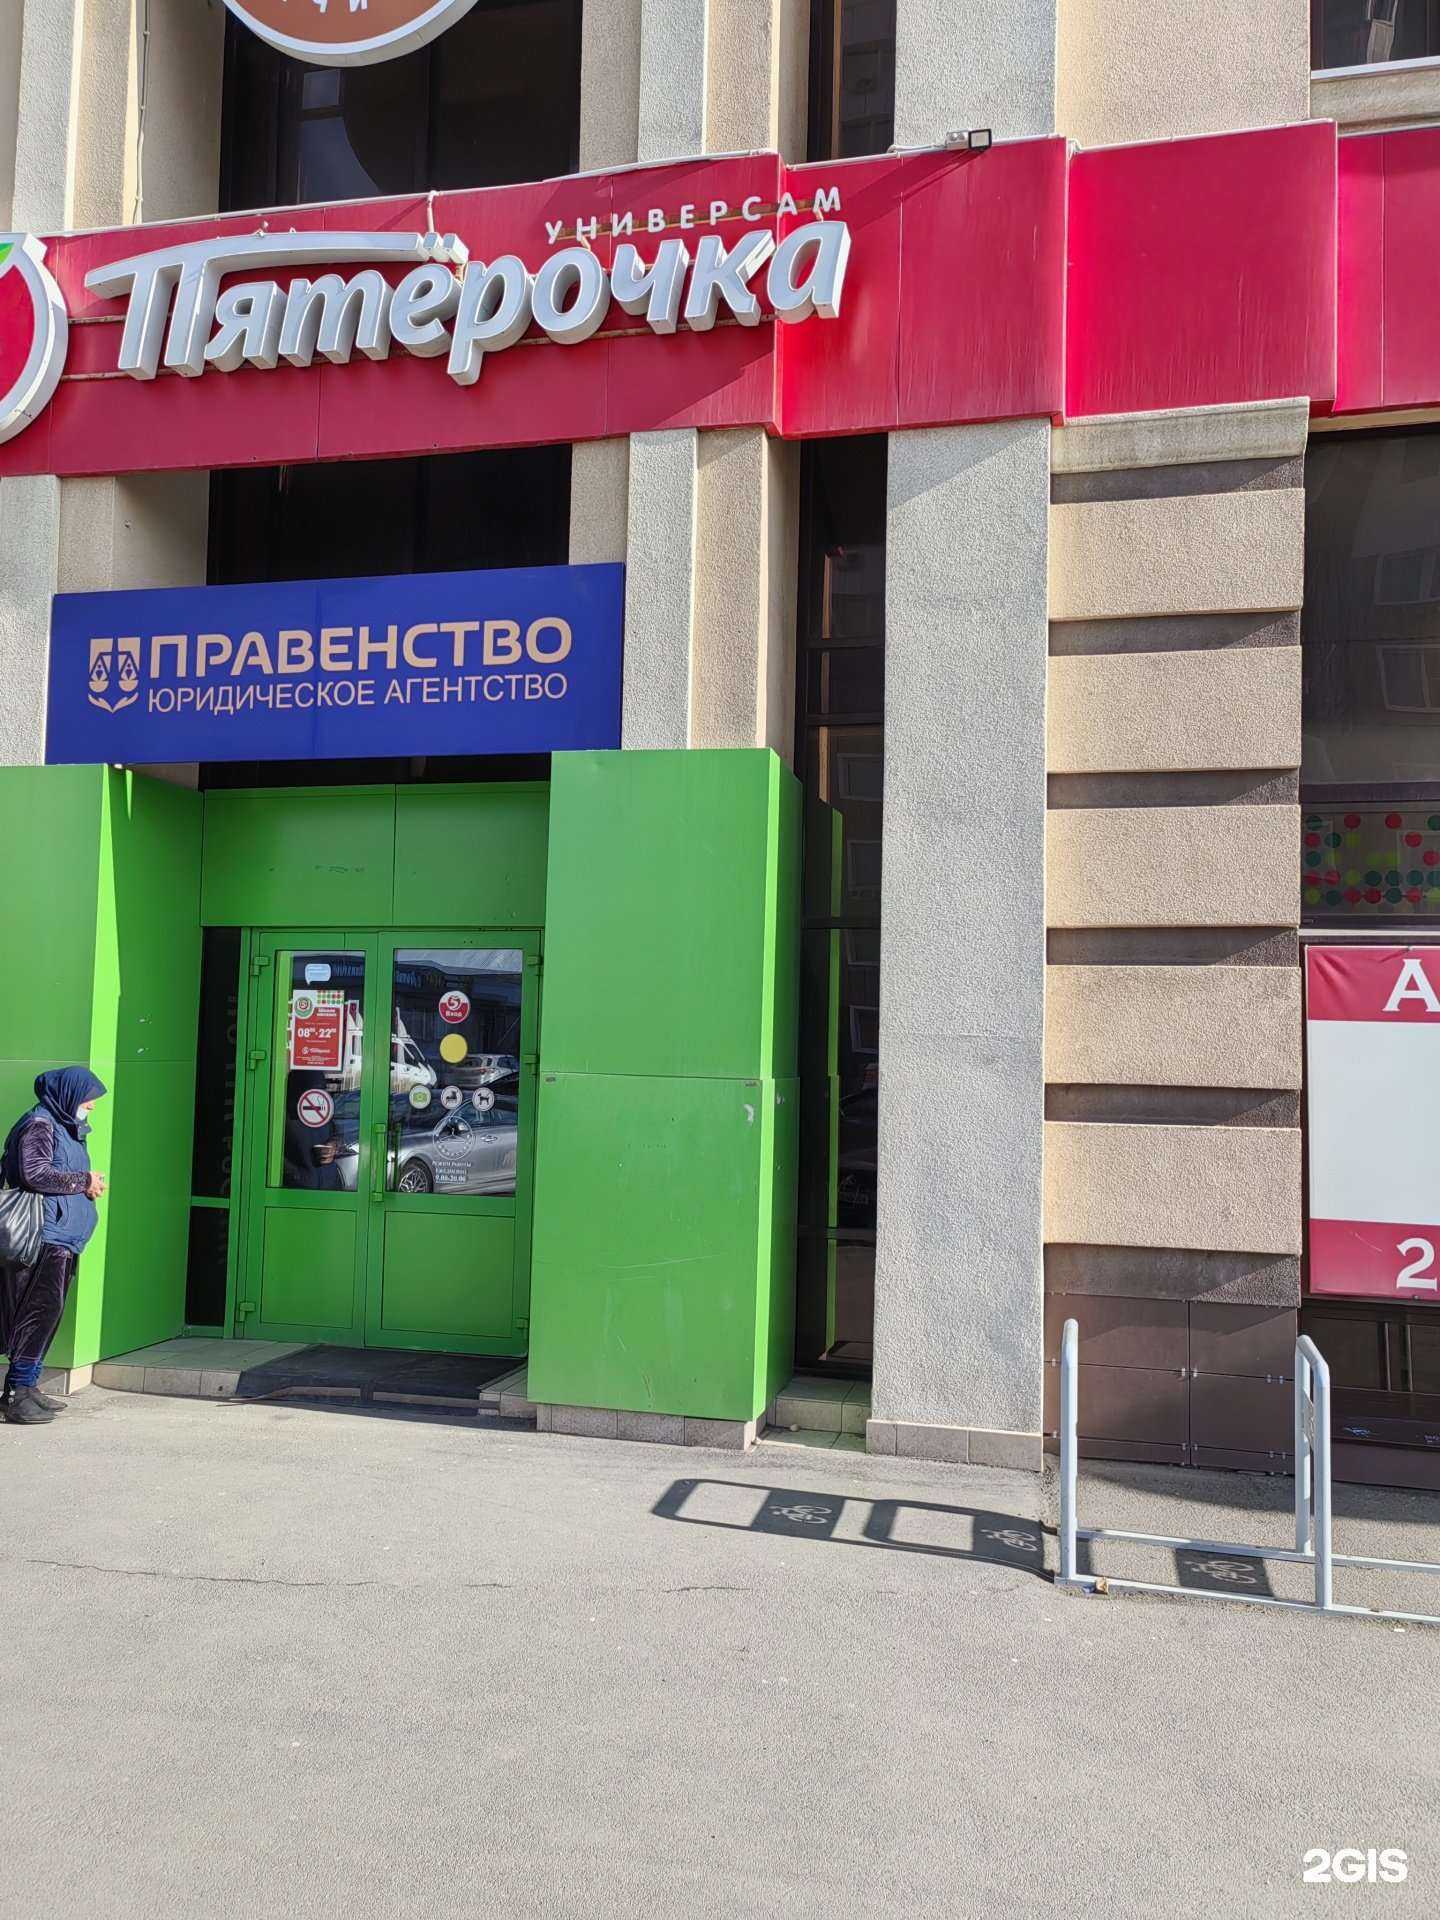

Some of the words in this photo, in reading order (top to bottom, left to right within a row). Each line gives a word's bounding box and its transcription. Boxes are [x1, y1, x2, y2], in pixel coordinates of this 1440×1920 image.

[546, 187, 841, 244] УНИВЕРСАМ
[84, 220, 852, 386] Пятёрочка
[149, 616, 573, 679] ПРАВЕНСТВО
[148, 679, 375, 716] ЮРИДИЧЕСКОЕ
[384, 673, 568, 705] АГЕНТСТВО
[1396, 1237, 1437, 1291] 2
